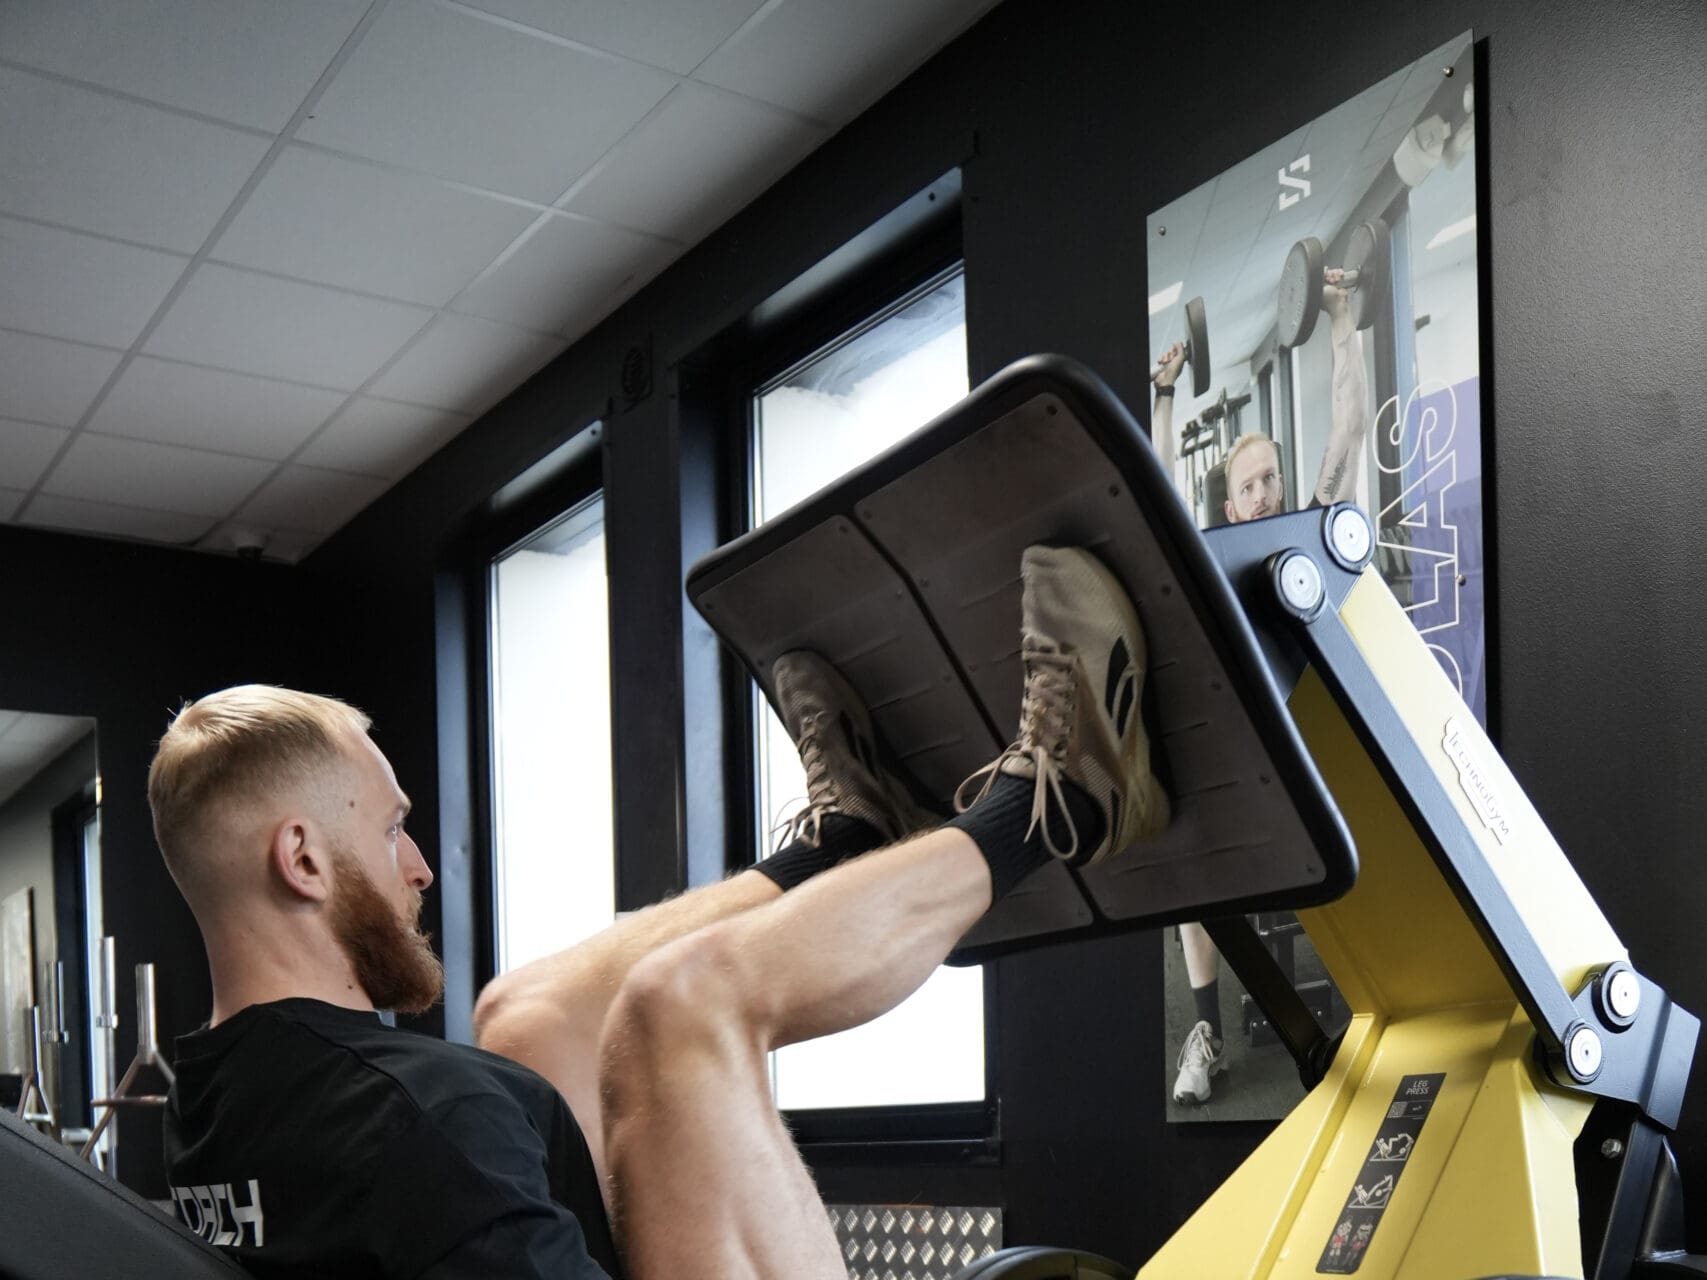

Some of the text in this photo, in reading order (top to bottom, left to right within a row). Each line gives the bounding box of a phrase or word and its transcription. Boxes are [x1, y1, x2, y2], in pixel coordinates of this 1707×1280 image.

[1412, 1080, 1429, 1088] LEG
[1405, 1087, 1430, 1096] PRESS
[170, 1179, 264, 1247] OACH
